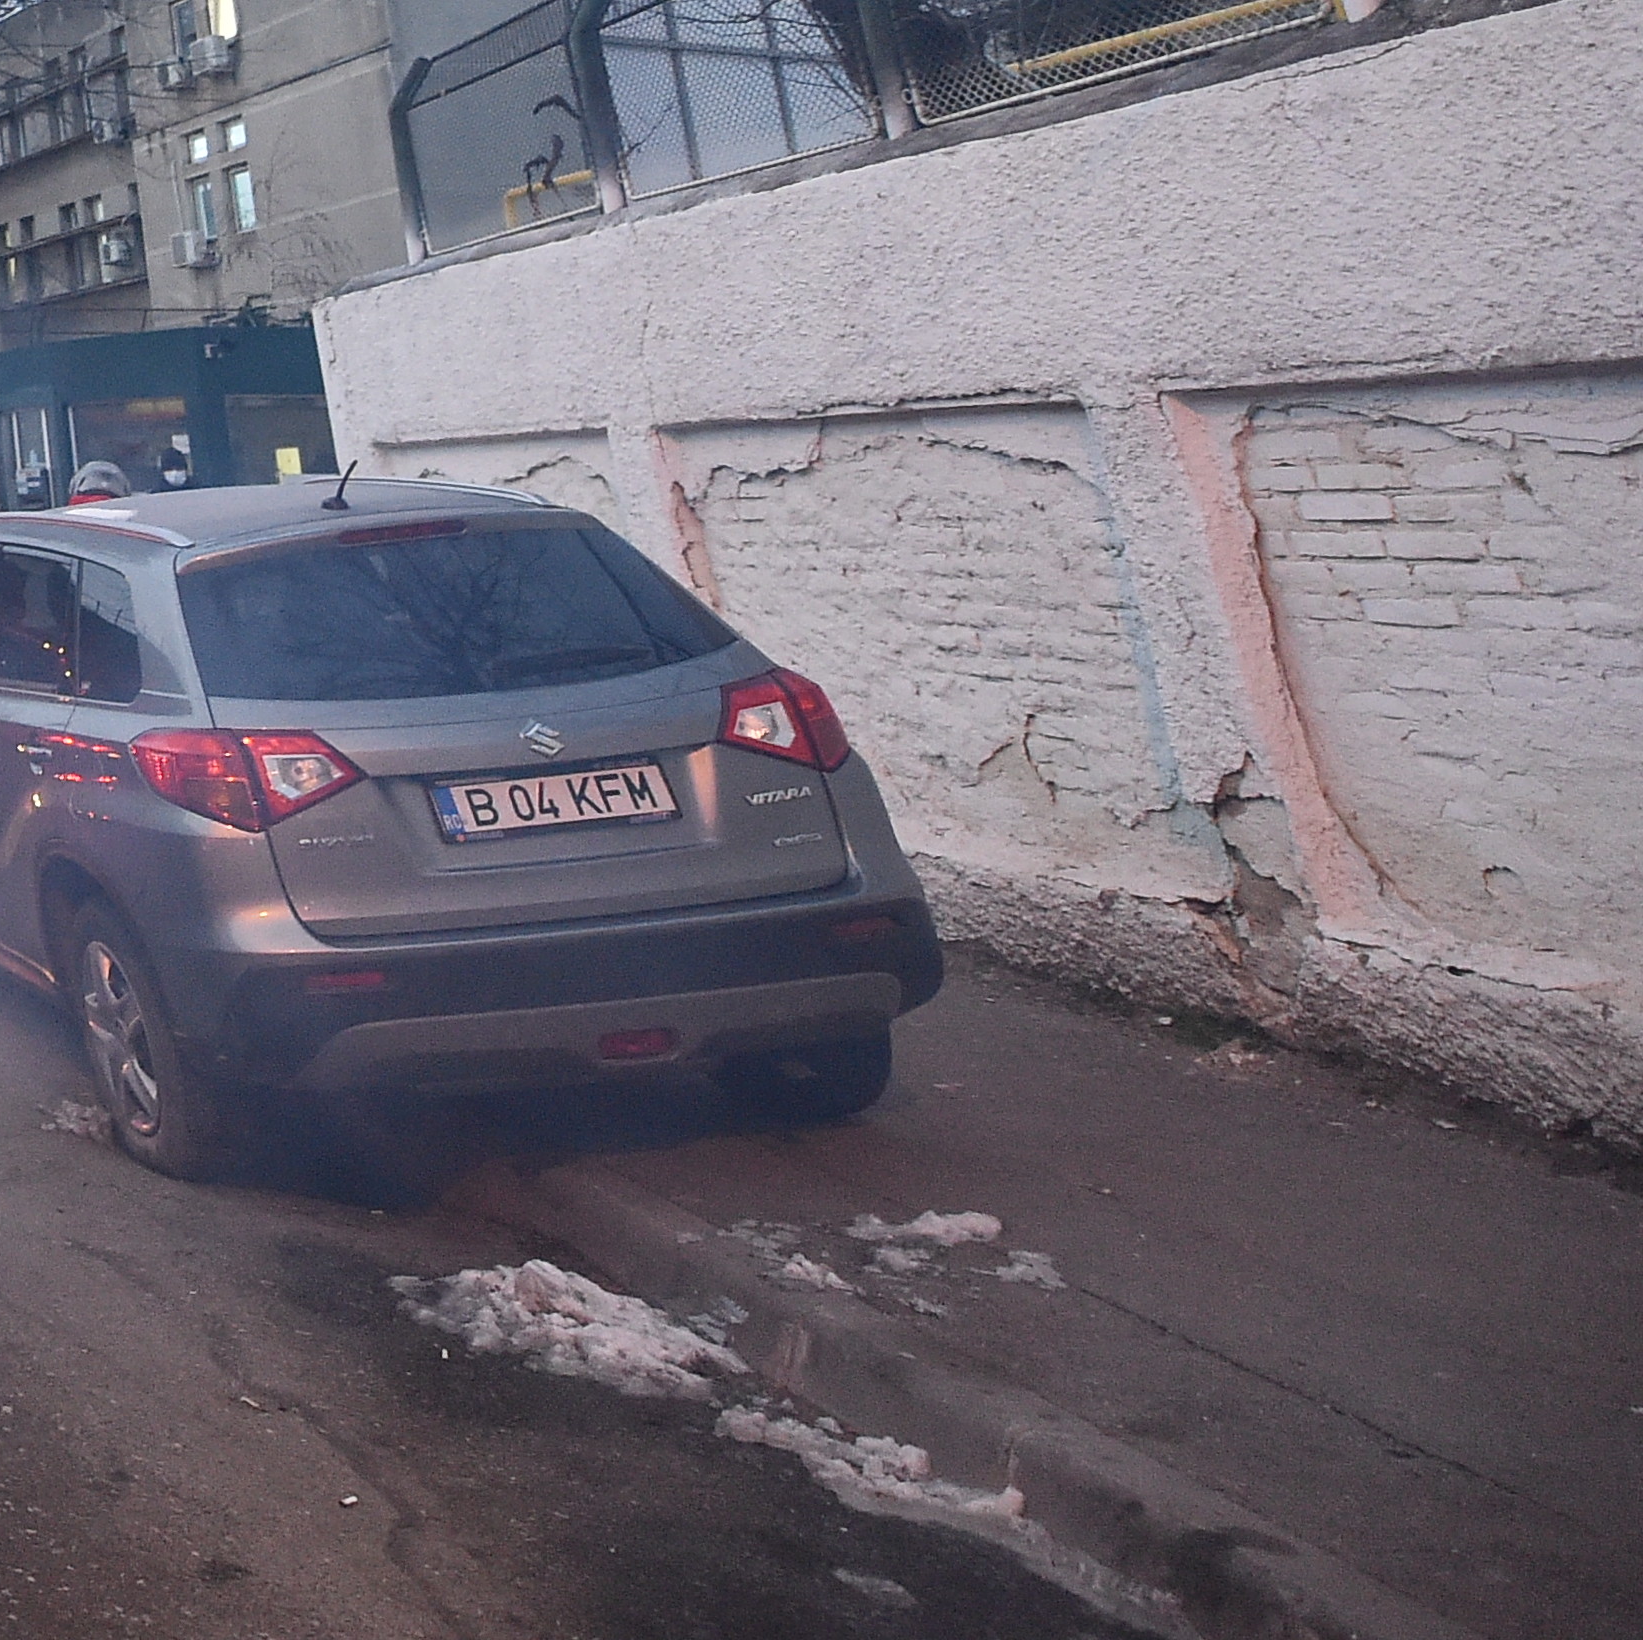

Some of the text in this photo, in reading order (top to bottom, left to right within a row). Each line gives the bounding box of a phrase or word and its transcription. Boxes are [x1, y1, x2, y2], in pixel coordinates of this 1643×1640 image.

[465, 787, 499, 826] B
[508, 783, 560, 822] 04
[566, 770, 658, 816] KFM
[744, 786, 811, 806] VITARA
